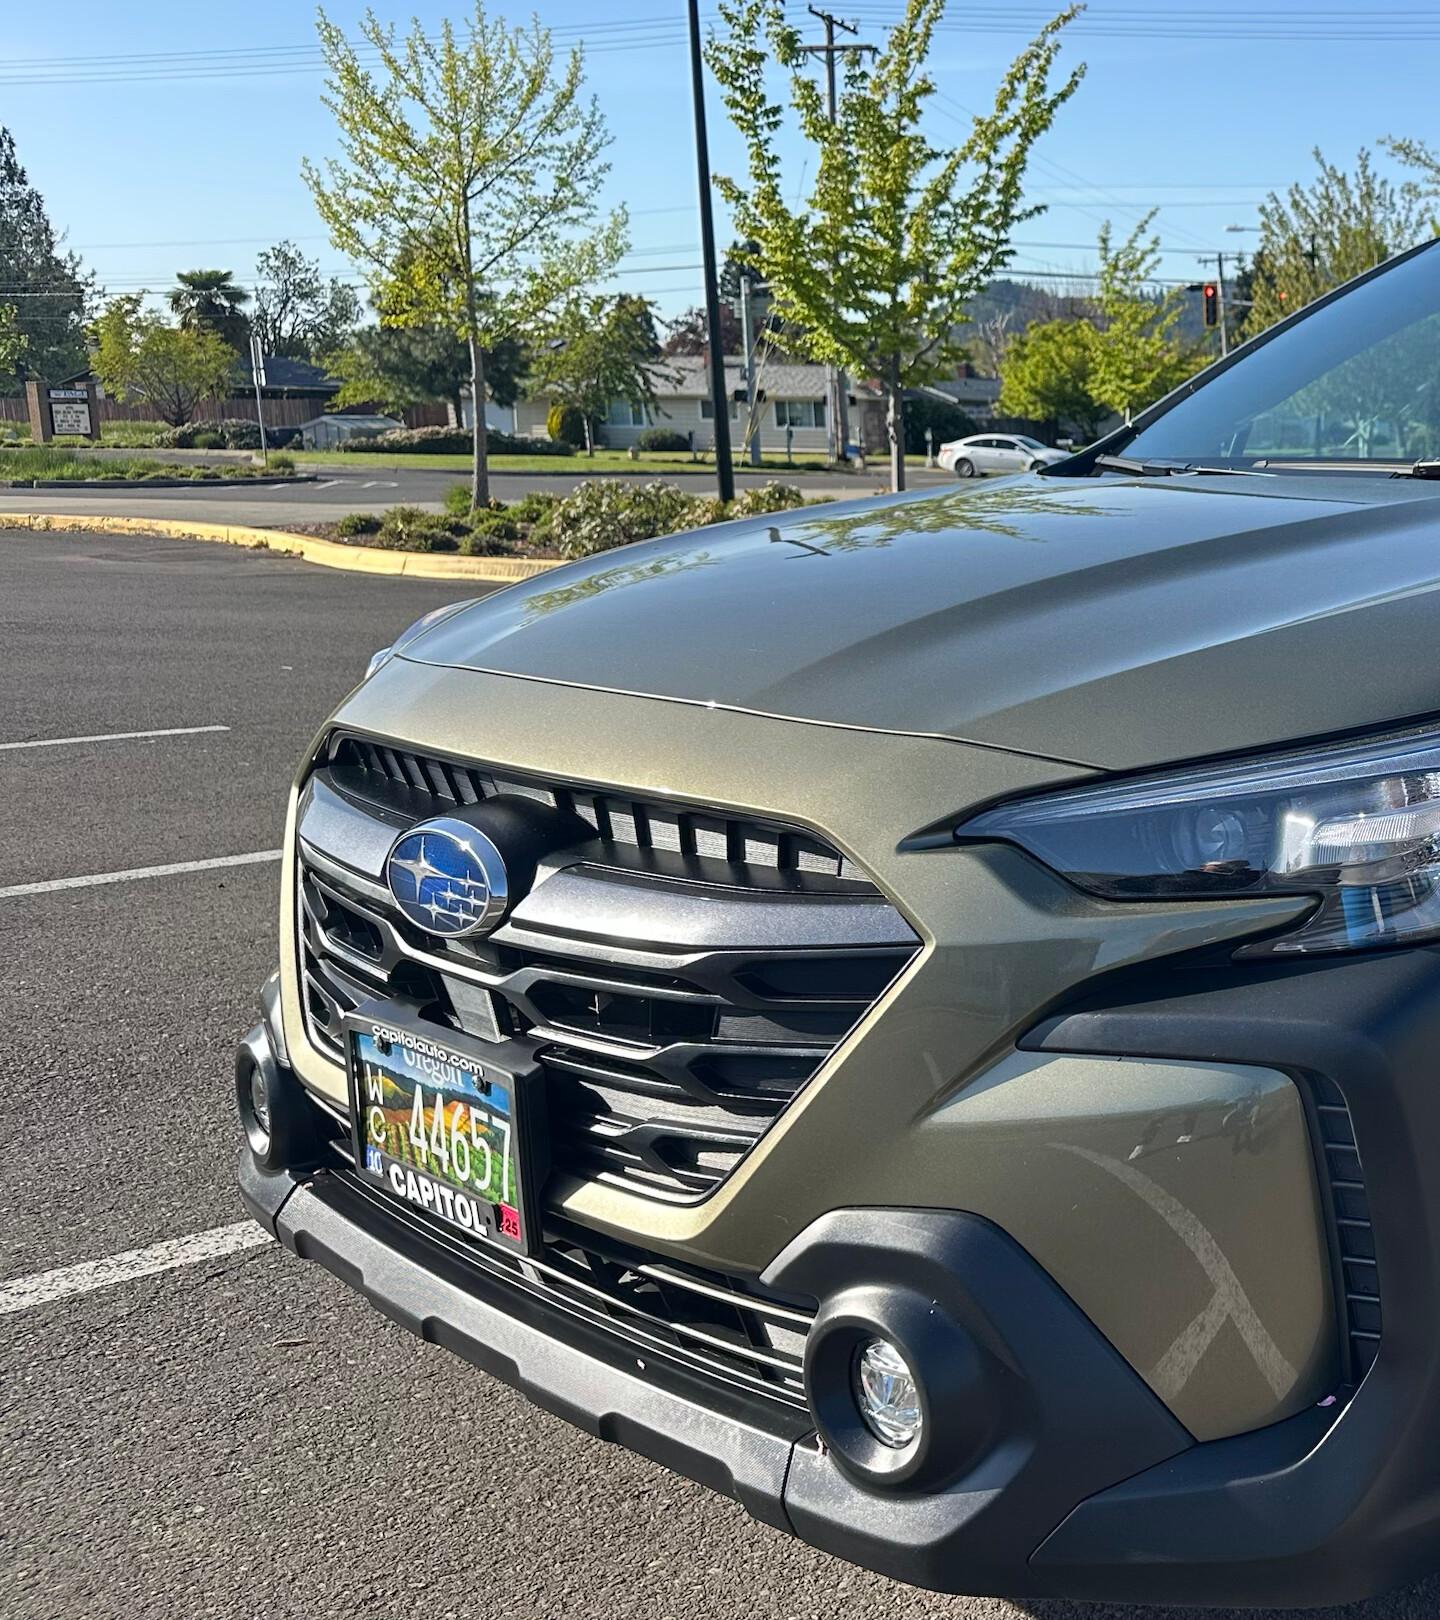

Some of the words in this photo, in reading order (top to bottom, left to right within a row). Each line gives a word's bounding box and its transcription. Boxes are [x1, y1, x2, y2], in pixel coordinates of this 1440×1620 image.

[372, 1025, 484, 1077] capitolauto.com
[403, 1048, 464, 1089] Oregon
[409, 1084, 511, 1202] 44657
[389, 1163, 488, 1237] CAPITOL
